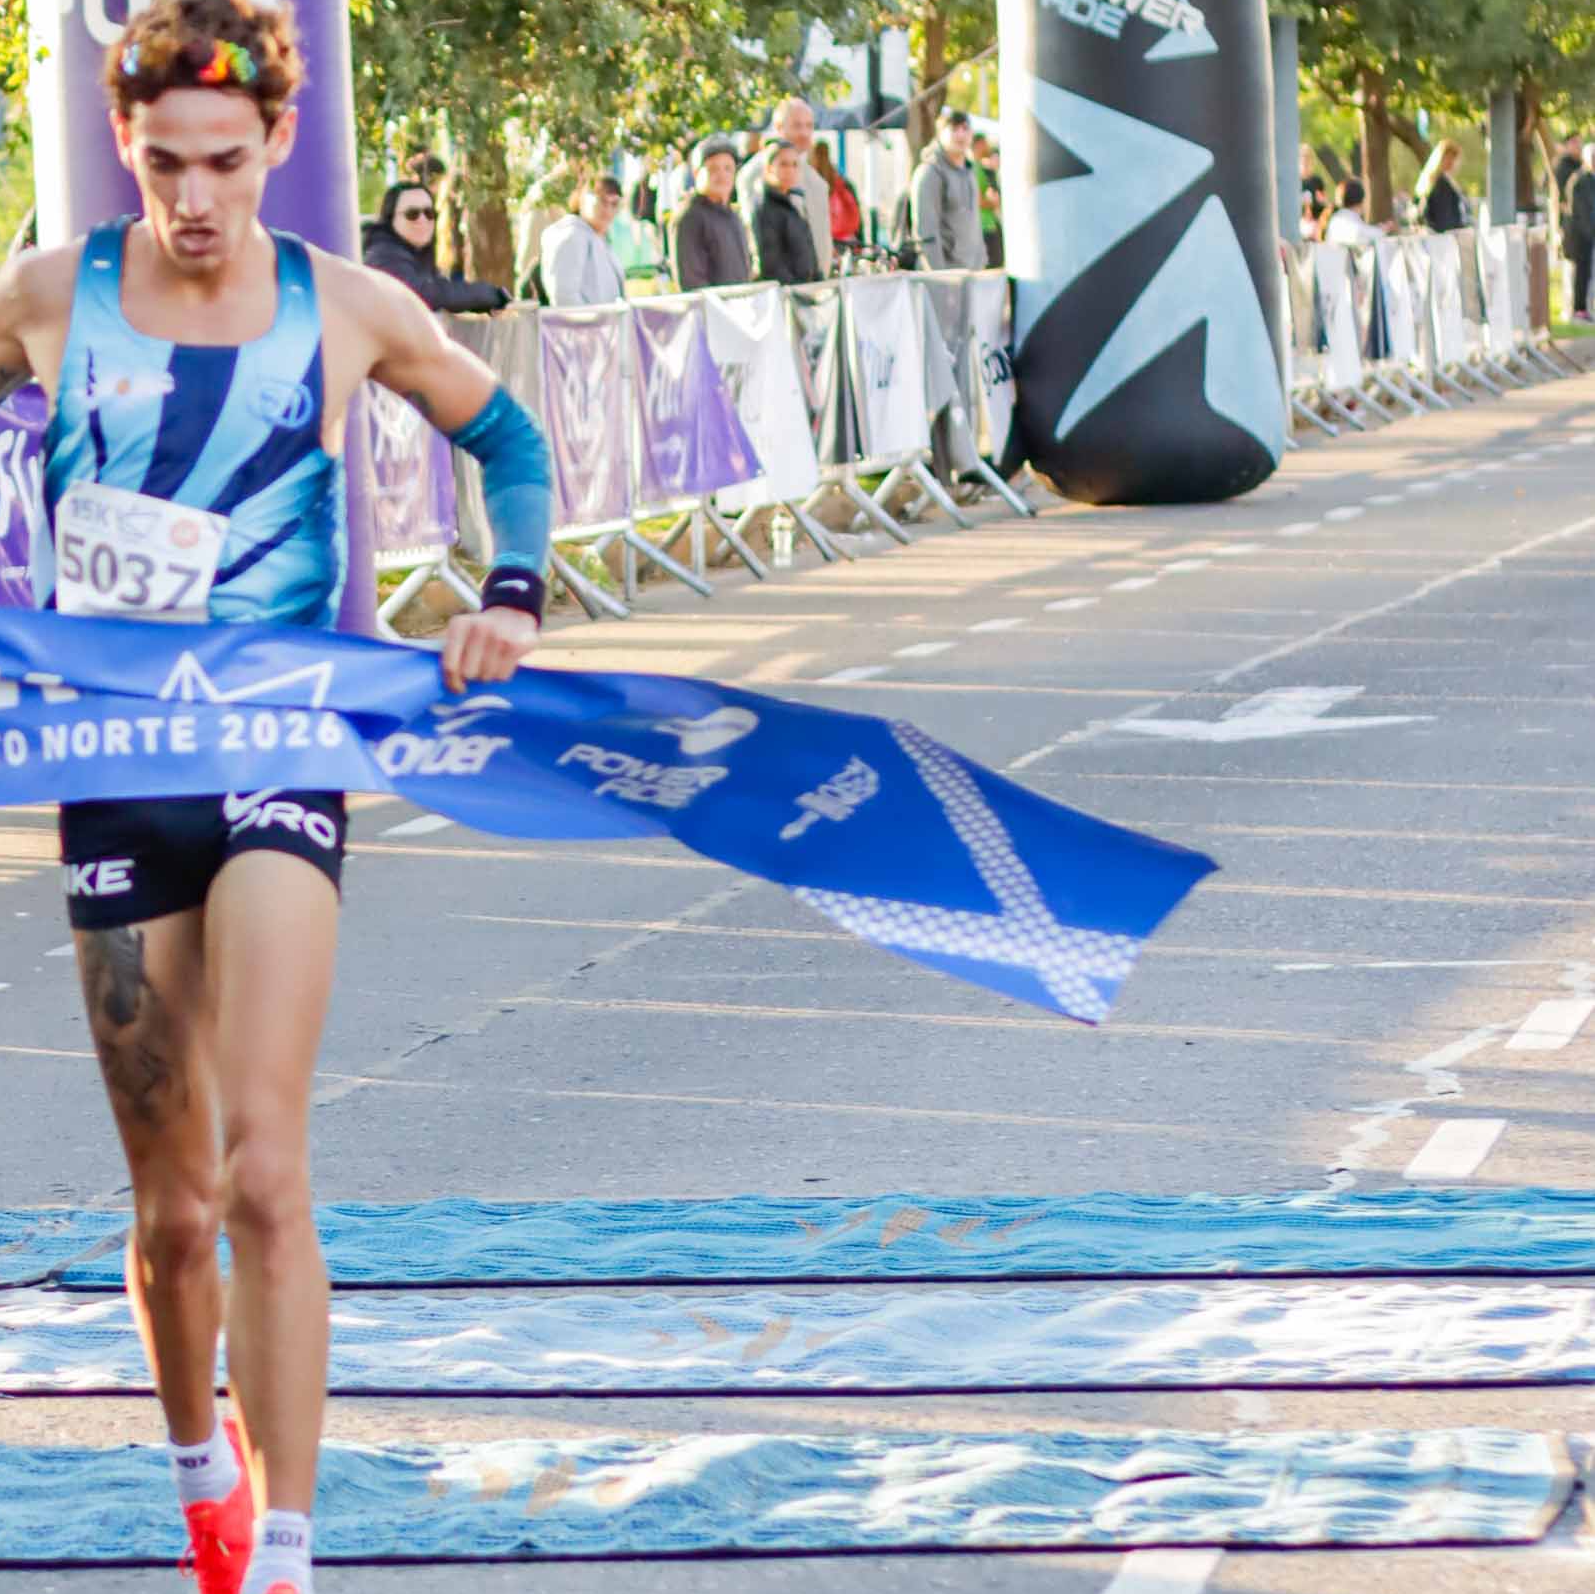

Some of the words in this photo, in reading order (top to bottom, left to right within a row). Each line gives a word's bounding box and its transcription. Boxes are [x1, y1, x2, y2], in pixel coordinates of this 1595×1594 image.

[62, 531, 202, 611] 5037
[41, 716, 197, 762] NORTE
[219, 712, 344, 750] 2026
[556, 743, 729, 789] POWER
